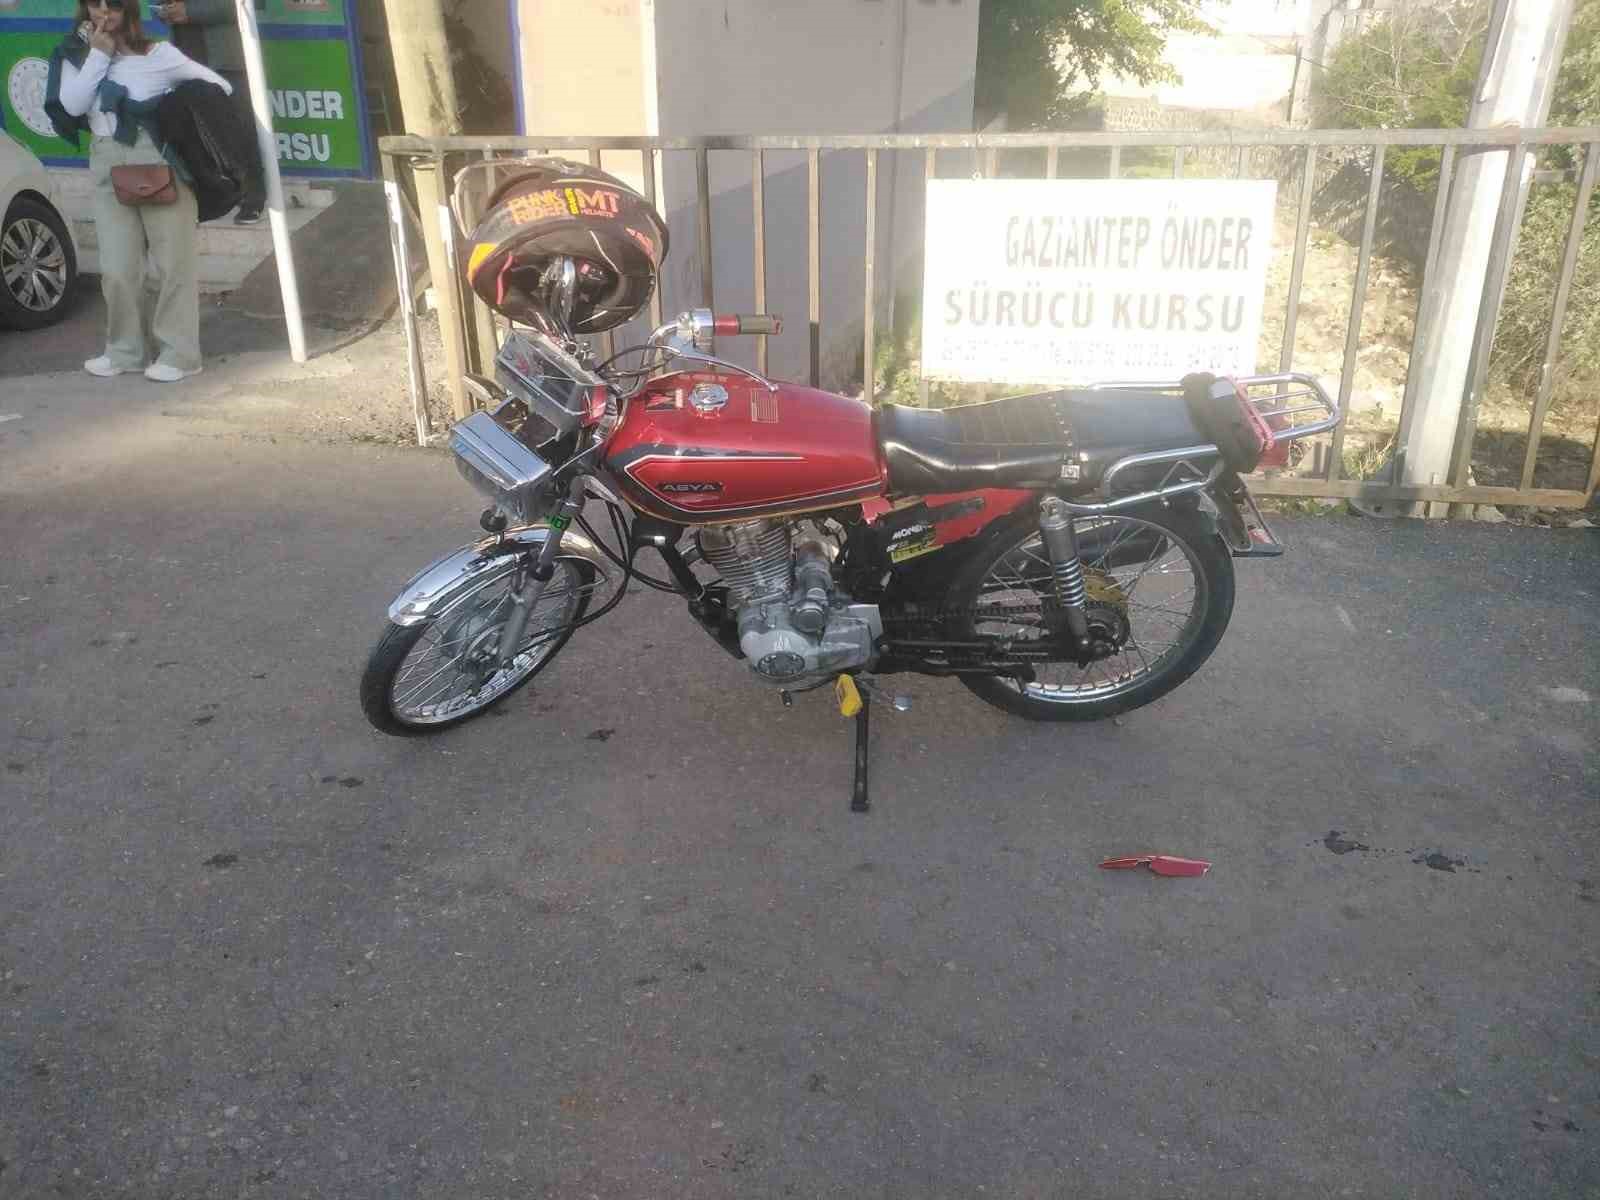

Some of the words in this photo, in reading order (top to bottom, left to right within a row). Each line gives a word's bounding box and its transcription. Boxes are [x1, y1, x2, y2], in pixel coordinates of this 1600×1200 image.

[267, 90, 344, 119] NDER
[274, 133, 330, 161] RSU
[576, 188, 620, 213] MT
[1160, 201, 1254, 271] ÖNDER
[944, 280, 1095, 328] SÜRÜCÜ
[1111, 291, 1246, 333] KURSU
